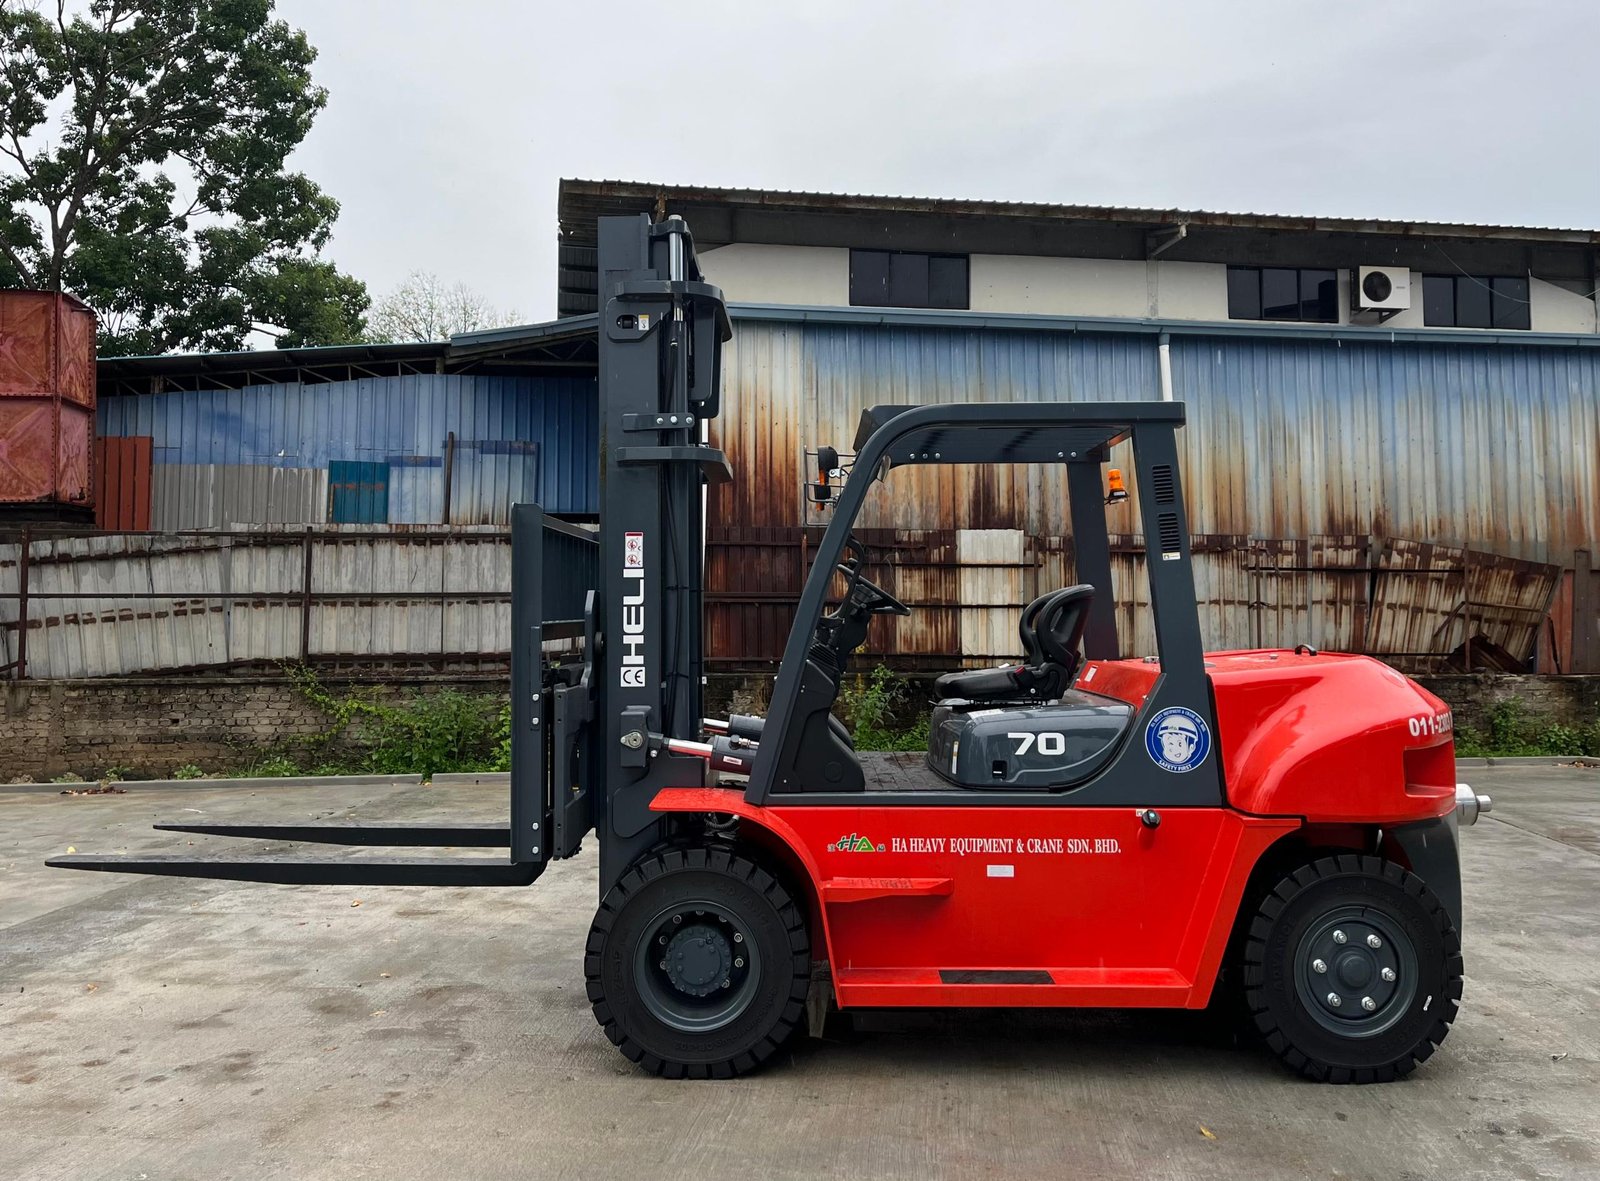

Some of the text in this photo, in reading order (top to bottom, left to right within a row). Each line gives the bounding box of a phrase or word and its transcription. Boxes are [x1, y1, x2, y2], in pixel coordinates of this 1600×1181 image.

[622, 568, 645, 665] HELI
[1007, 732, 1066, 756] 70
[1159, 760, 1177, 771] SAFETY
[891, 837, 908, 853] HA
[909, 837, 946, 853] HEAVY
[950, 837, 1014, 856] EQUIPMENT
[1016, 838, 1025, 853] &
[1027, 838, 1063, 854] CRANE
[1067, 838, 1092, 854] SDN.
[1094, 838, 1121, 854] BHD.
